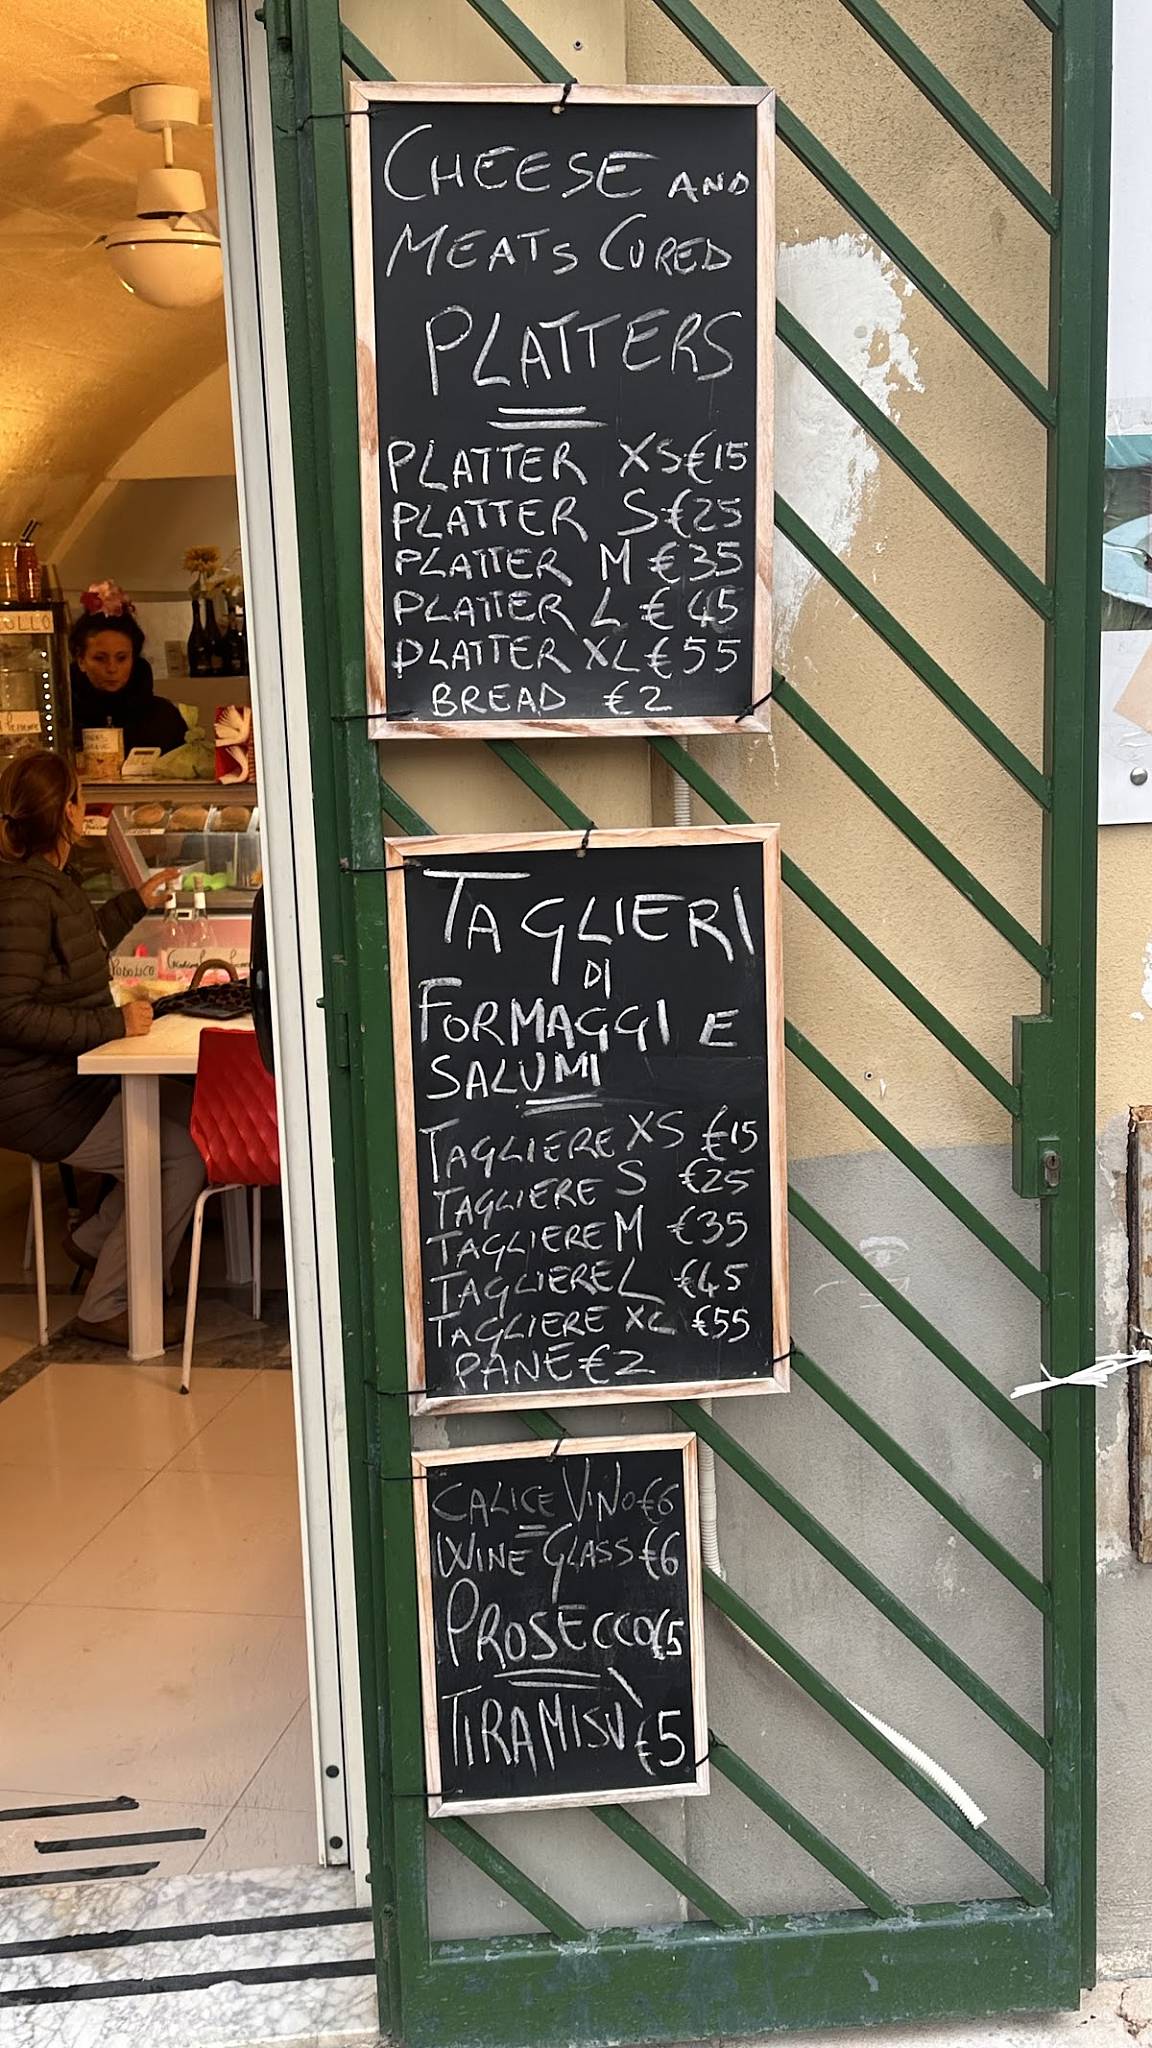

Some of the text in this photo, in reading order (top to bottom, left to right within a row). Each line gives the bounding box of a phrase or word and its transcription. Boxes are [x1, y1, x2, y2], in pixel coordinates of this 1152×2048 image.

[384, 123, 750, 203] CHEESE AND
[386, 213, 733, 277] MEATS CURED
[426, 305, 742, 396] PLATTERS
[387, 440, 589, 493] PLATTER
[683, 430, 749, 484] €15
[392, 488, 742, 542] PLATTER S €25
[395, 547, 574, 586] PLATTER
[599, 539, 632, 585] M
[393, 590, 579, 635] PLATTER
[590, 587, 621, 628] L
[392, 635, 572, 679] PLATTER
[583, 636, 640, 673] XL
[431, 680, 672, 718] BREAD €2
[423, 868, 755, 985] TAGLIERI
[584, 958, 612, 999] DI
[418, 977, 740, 1053] FORMAGGI E
[426, 1051, 602, 1100] SALUMI
[419, 1105, 758, 1183] TAGLIERE XS €15
[433, 1158, 755, 1230] TAGLIERE S €25
[426, 1205, 748, 1272] TAGLIERE M €35
[430, 1257, 749, 1319] TAGLIERE L €45
[429, 1306, 610, 1358] TAGLIERE
[691, 1305, 751, 1343] €55
[455, 1342, 656, 1391] PANE €2
[432, 1482, 554, 1527] CALICE
[562, 1458, 636, 1522] VINO
[436, 1522, 681, 1604] WINE GLASS €6
[446, 1578, 685, 1669] PROSECCO €5
[634, 1709, 686, 1776] €5
